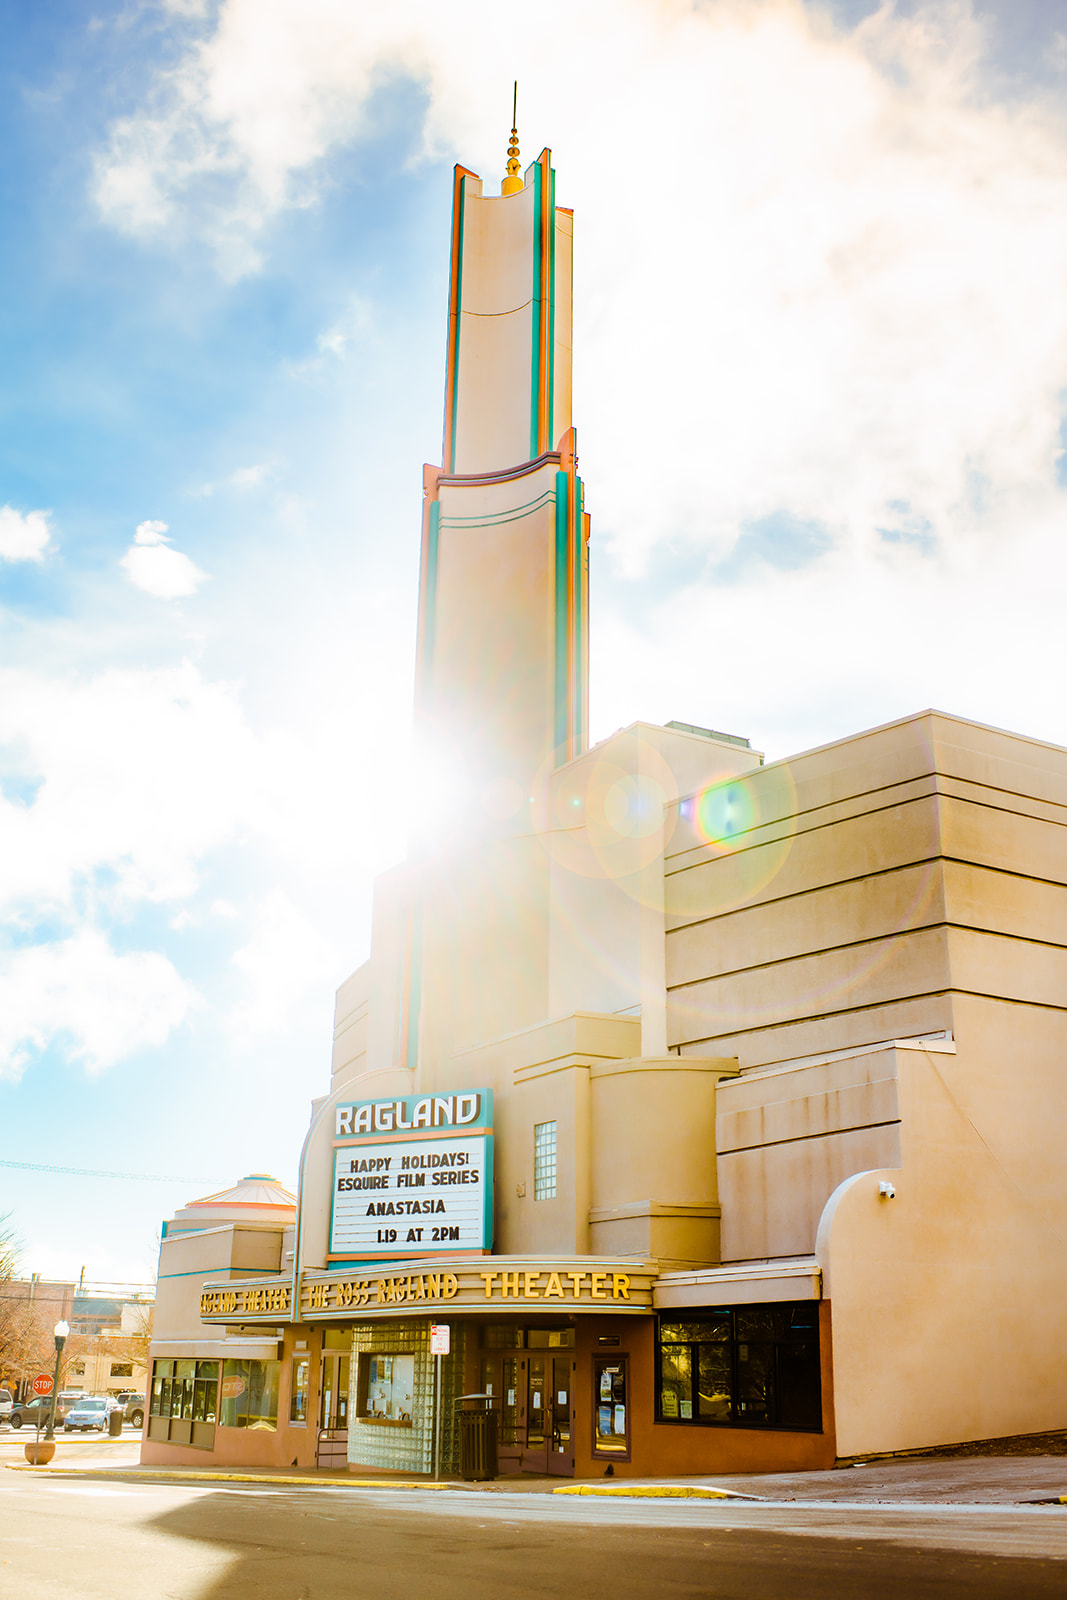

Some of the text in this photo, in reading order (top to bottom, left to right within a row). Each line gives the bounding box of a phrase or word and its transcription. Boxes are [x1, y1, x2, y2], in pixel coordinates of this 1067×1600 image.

[335, 1093, 481, 1135] RAGLAND
[350, 1152, 469, 1173] HAPPY HOLIDAYS!
[337, 1170, 480, 1192] ESQUIRE FILM SERIES
[366, 1199, 446, 1217] ANASTASIA
[377, 1226, 460, 1243] 1.19 AT 2PM
[242, 1288, 288, 1313] THEATER
[307, 1272, 631, 1308] THE ROSS RAGLAND THEATER
[34, 1380, 53, 1389] STOP
